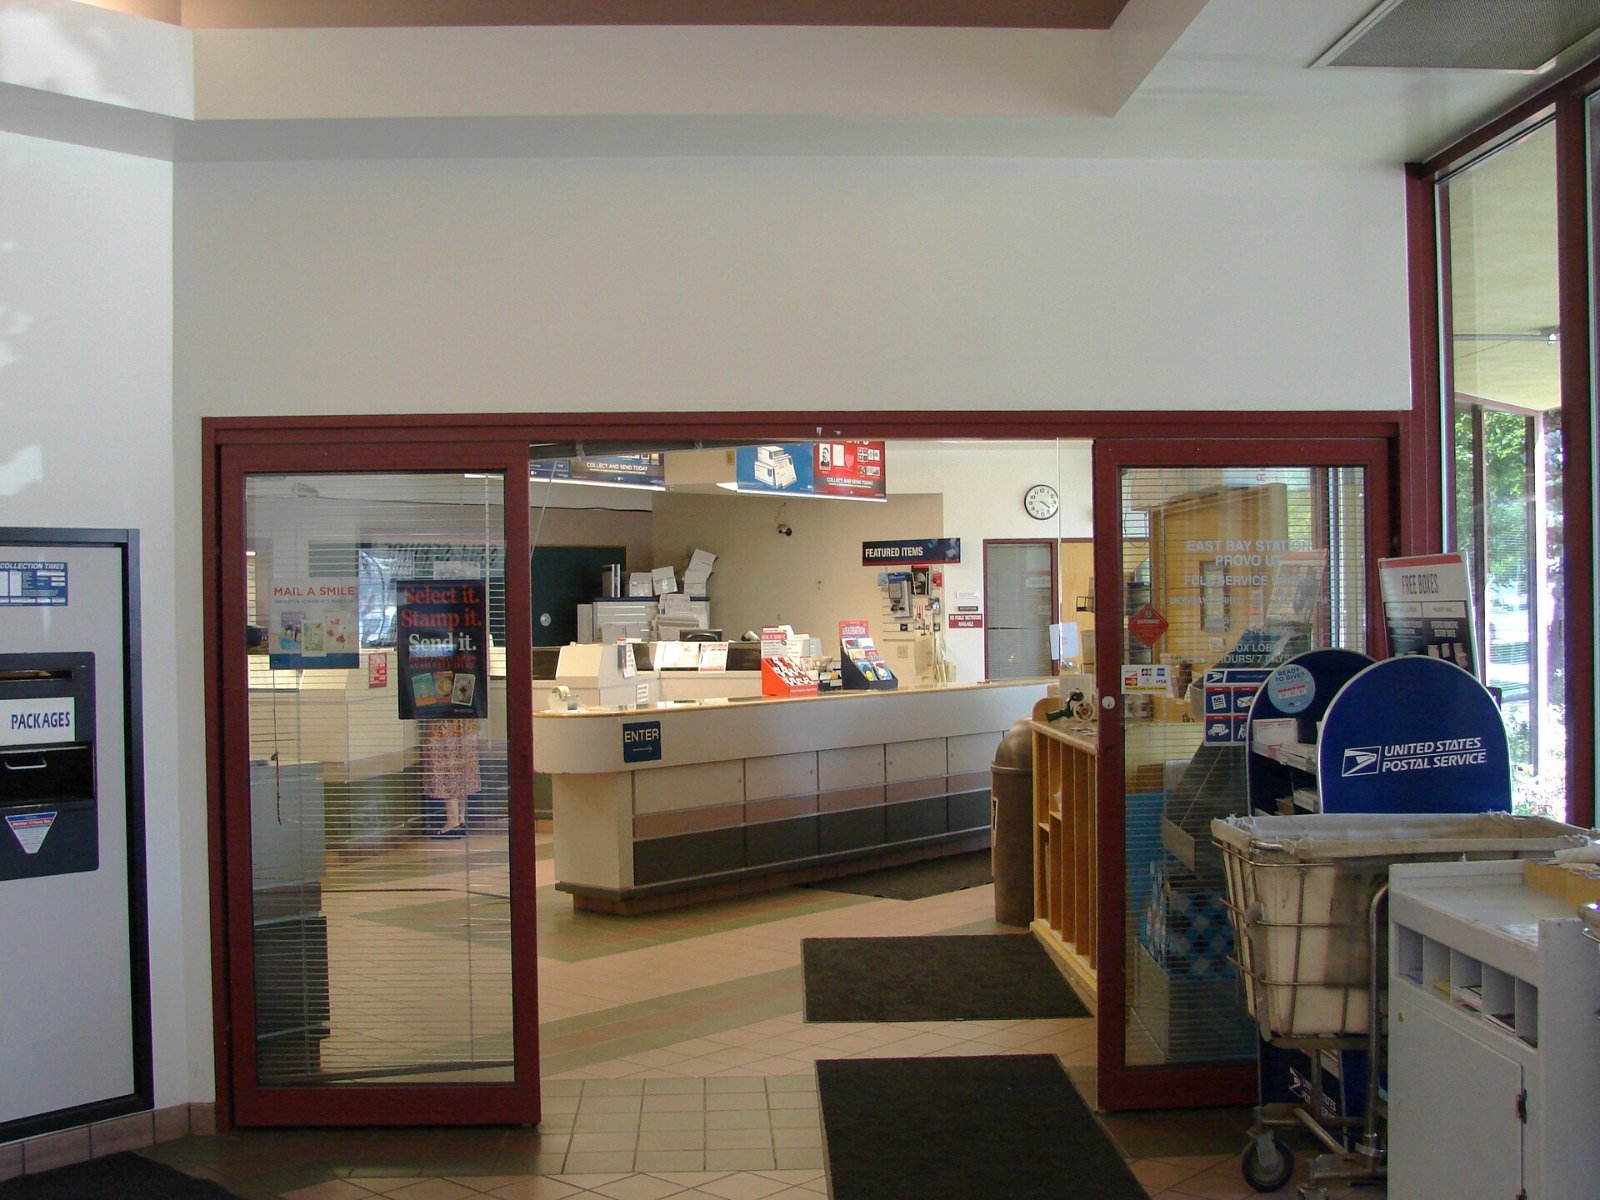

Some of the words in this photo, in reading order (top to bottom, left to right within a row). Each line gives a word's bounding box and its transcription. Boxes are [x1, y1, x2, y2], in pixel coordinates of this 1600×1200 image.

[587, 462, 609, 470] COLLECT
[865, 547, 900, 558] FEATURED
[901, 546, 924, 557] ITEMS
[1186, 540, 1222, 552] EAST
[1226, 540, 1252, 552] BAY
[1255, 540, 1313, 551] STATION
[1215, 554, 1262, 567] PROVO
[1219, 575, 1268, 586] SERVICE
[1401, 574, 1418, 595] FREE
[1418, 573, 1439, 594] BOXES
[274, 586, 303, 597] MAIL
[306, 587, 316, 596] A
[319, 586, 356, 597] SMILE
[404, 584, 458, 605] Select
[462, 584, 481, 604] it.
[401, 608, 460, 632] Stamp
[464, 607, 483, 627] it.
[408, 632, 453, 652] Send
[458, 632, 477, 652] it.
[1256, 655, 1262, 664] 7
[1277, 667, 1300, 677] READY
[11, 711, 71, 730] PACKAGES
[624, 728, 660, 742] ENTER
[1384, 741, 1435, 757] UNITED
[1436, 736, 1482, 752] STATES
[1382, 758, 1431, 773] POSTAL
[1433, 752, 1487, 768] SERVICE
